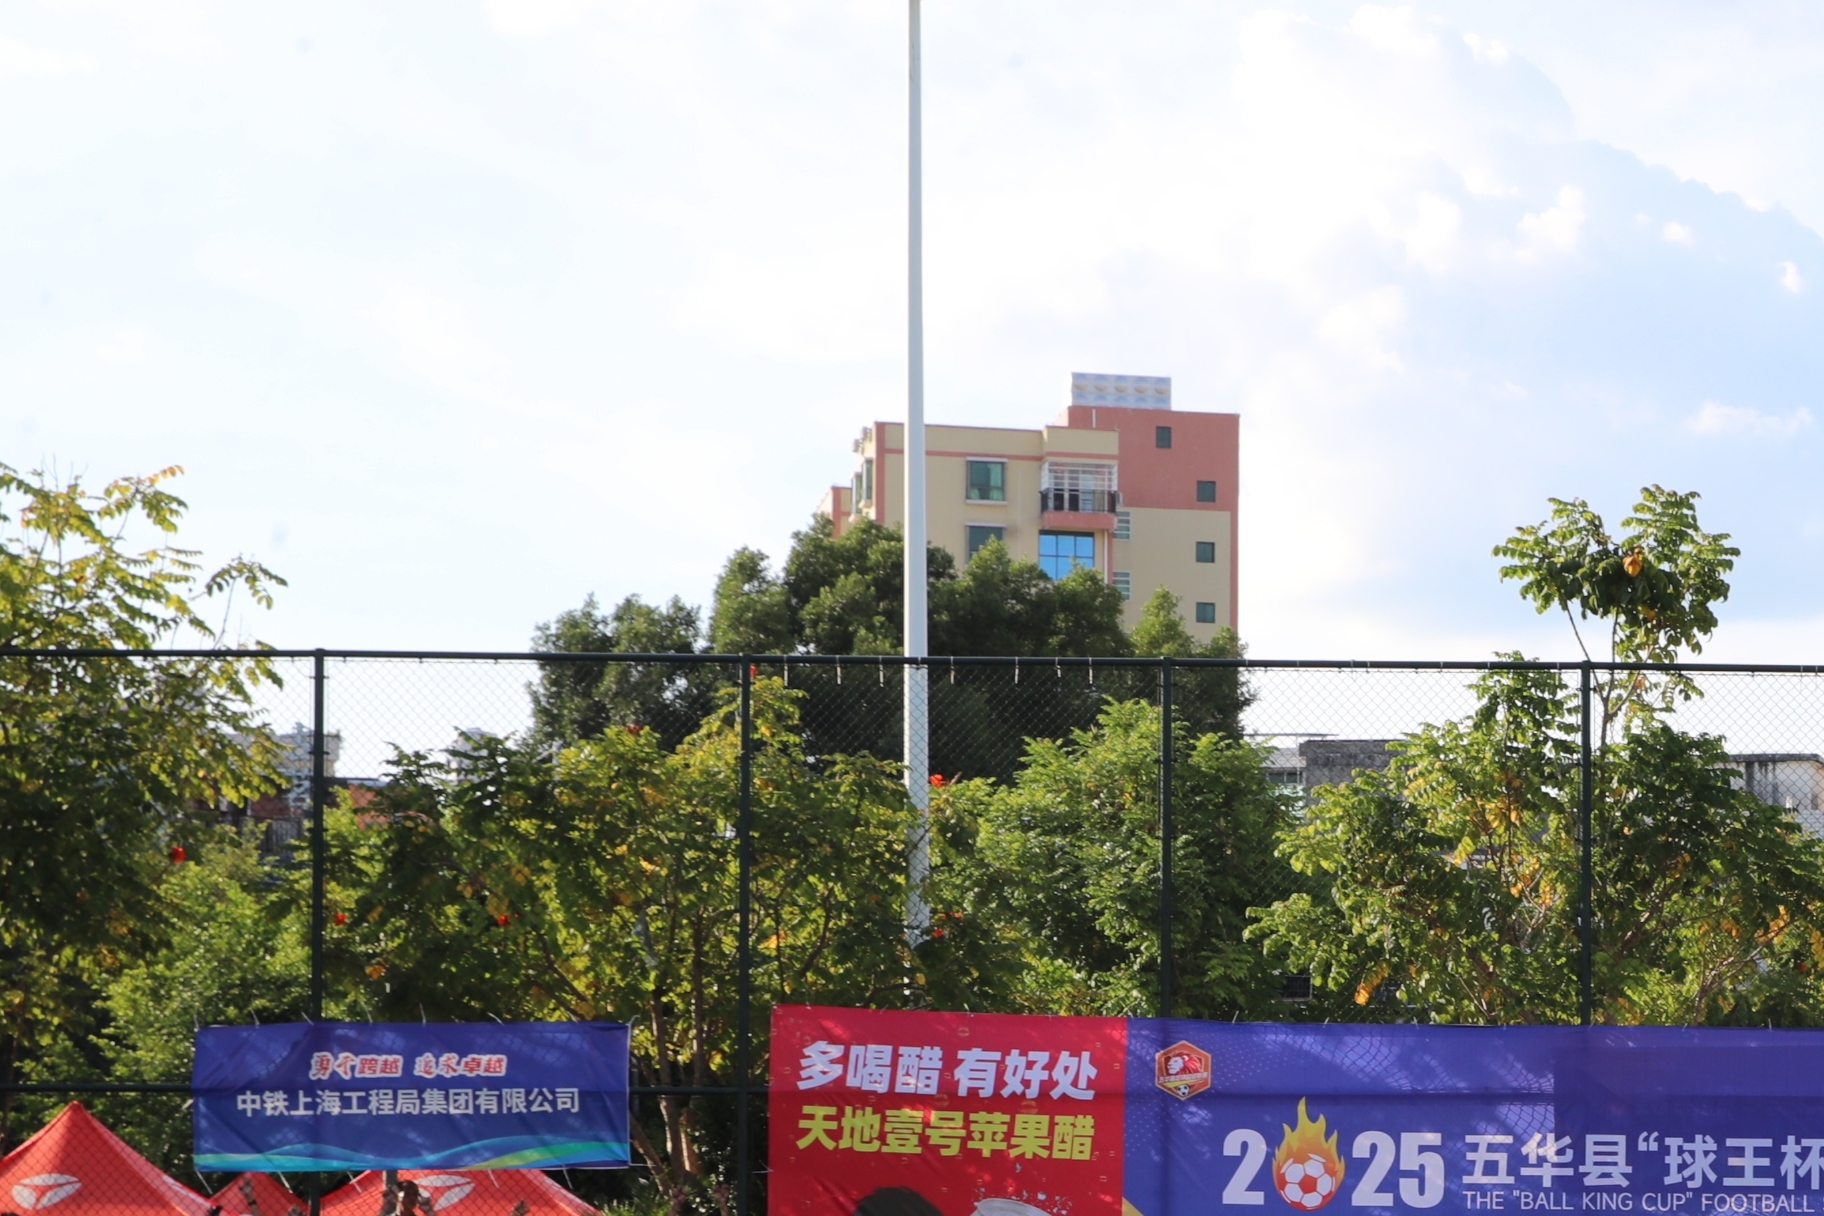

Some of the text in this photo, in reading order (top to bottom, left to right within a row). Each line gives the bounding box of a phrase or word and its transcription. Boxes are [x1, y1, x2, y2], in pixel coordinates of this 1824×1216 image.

[415, 1052, 507, 1078] 追求卓越
[797, 1040, 1098, 1100] 多喝醋 有好处
[236, 1086, 580, 1117] 中铁上海工程局集团有限公司
[795, 1104, 1096, 1161] 天地壹号苹果醋
[1463, 1191, 1505, 1210] THE
[1582, 1191, 1633, 1211] KING
[1702, 1193, 1815, 1213] FOOTBALL
